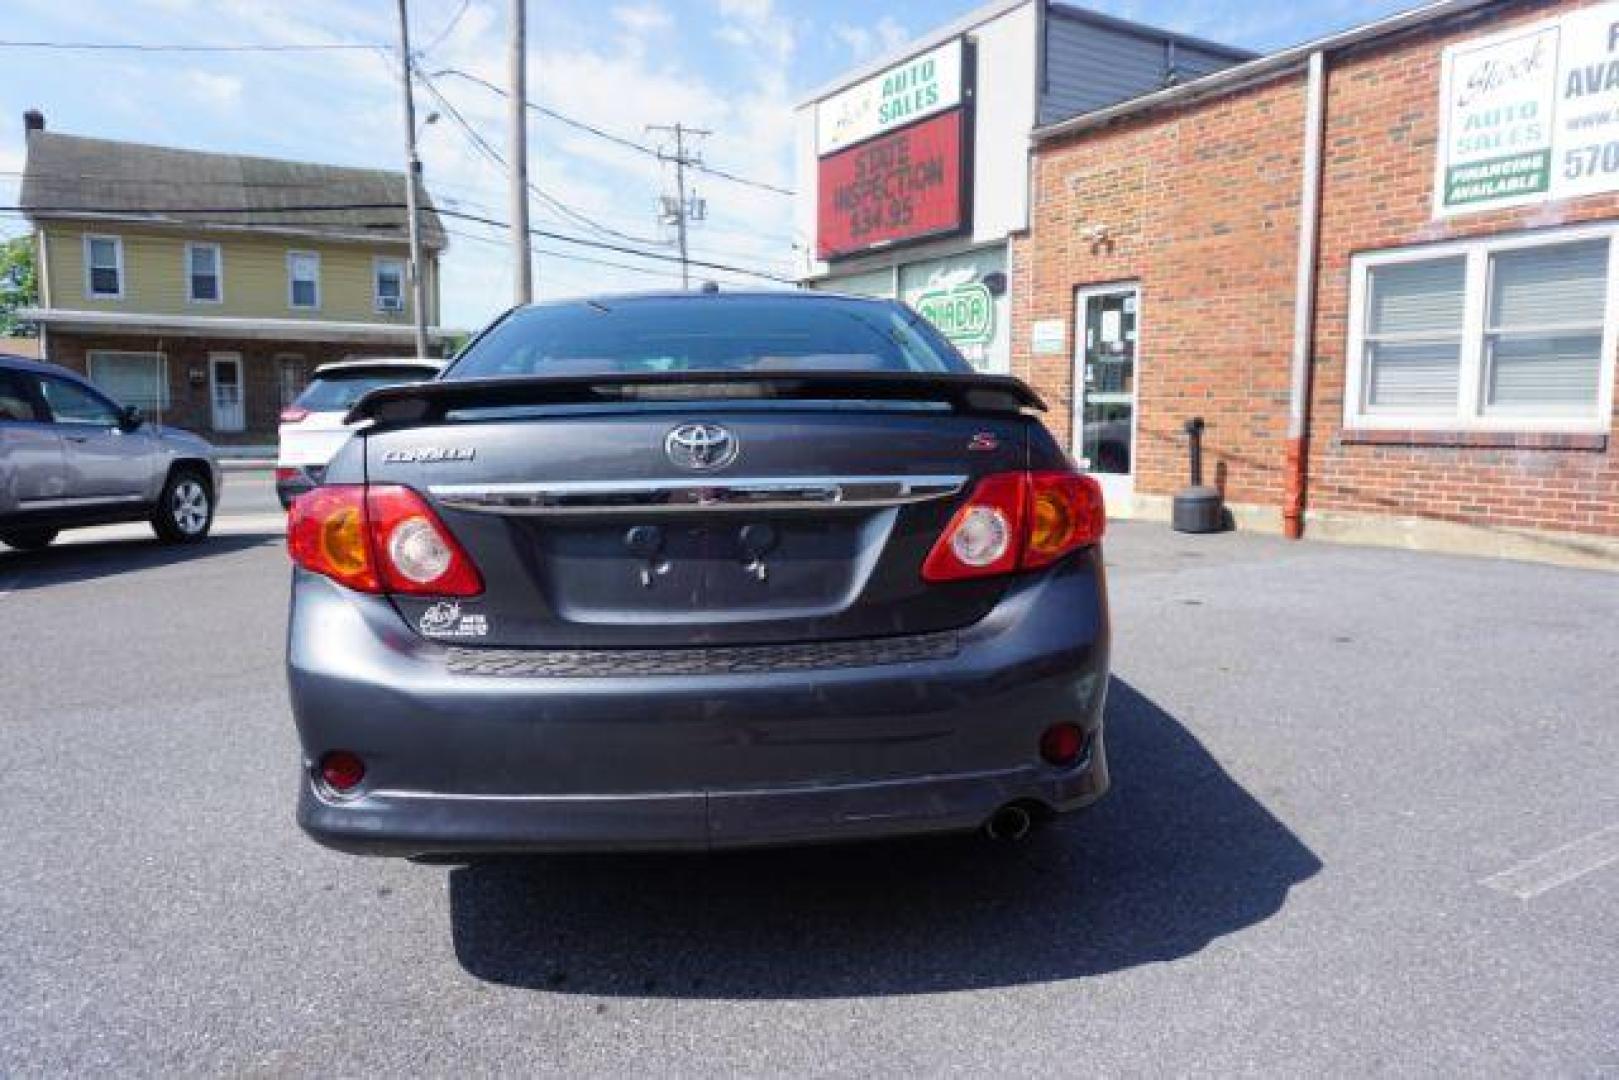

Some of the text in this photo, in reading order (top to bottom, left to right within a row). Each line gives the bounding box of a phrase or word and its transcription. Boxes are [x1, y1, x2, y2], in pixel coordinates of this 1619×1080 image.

[882, 60, 935, 97] AUTO
[878, 82, 940, 124] SALES
[1464, 101, 1538, 131] AUTO
[1457, 122, 1541, 154] SALES
[854, 136, 911, 180] STATE
[832, 153, 944, 211] INSPECTION
[1450, 174, 1538, 200] AVAILABLE
